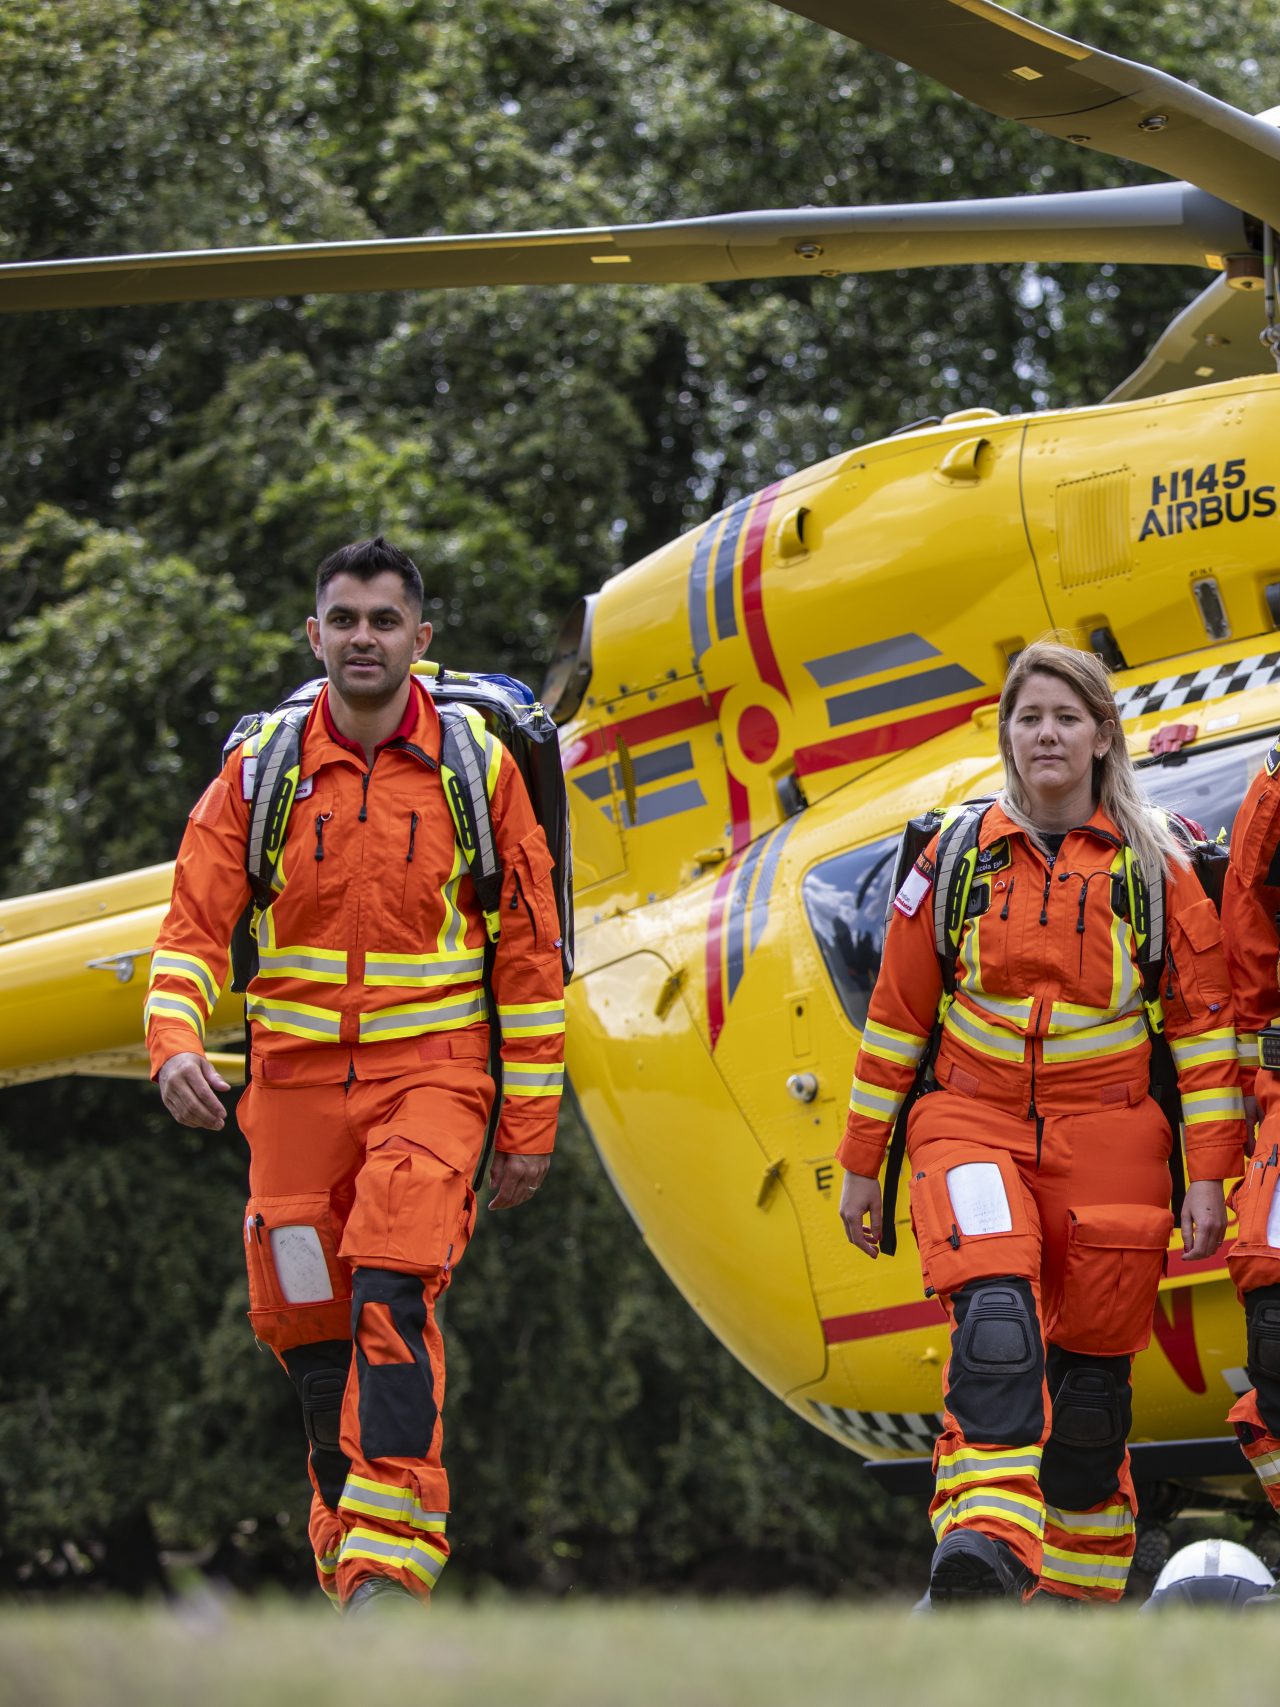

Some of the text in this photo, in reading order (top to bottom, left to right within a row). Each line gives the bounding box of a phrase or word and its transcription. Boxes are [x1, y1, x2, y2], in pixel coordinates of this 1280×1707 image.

[1152, 458, 1246, 505] H145
[1138, 486, 1276, 542] AIRBUS
[815, 1165, 833, 1191] E
